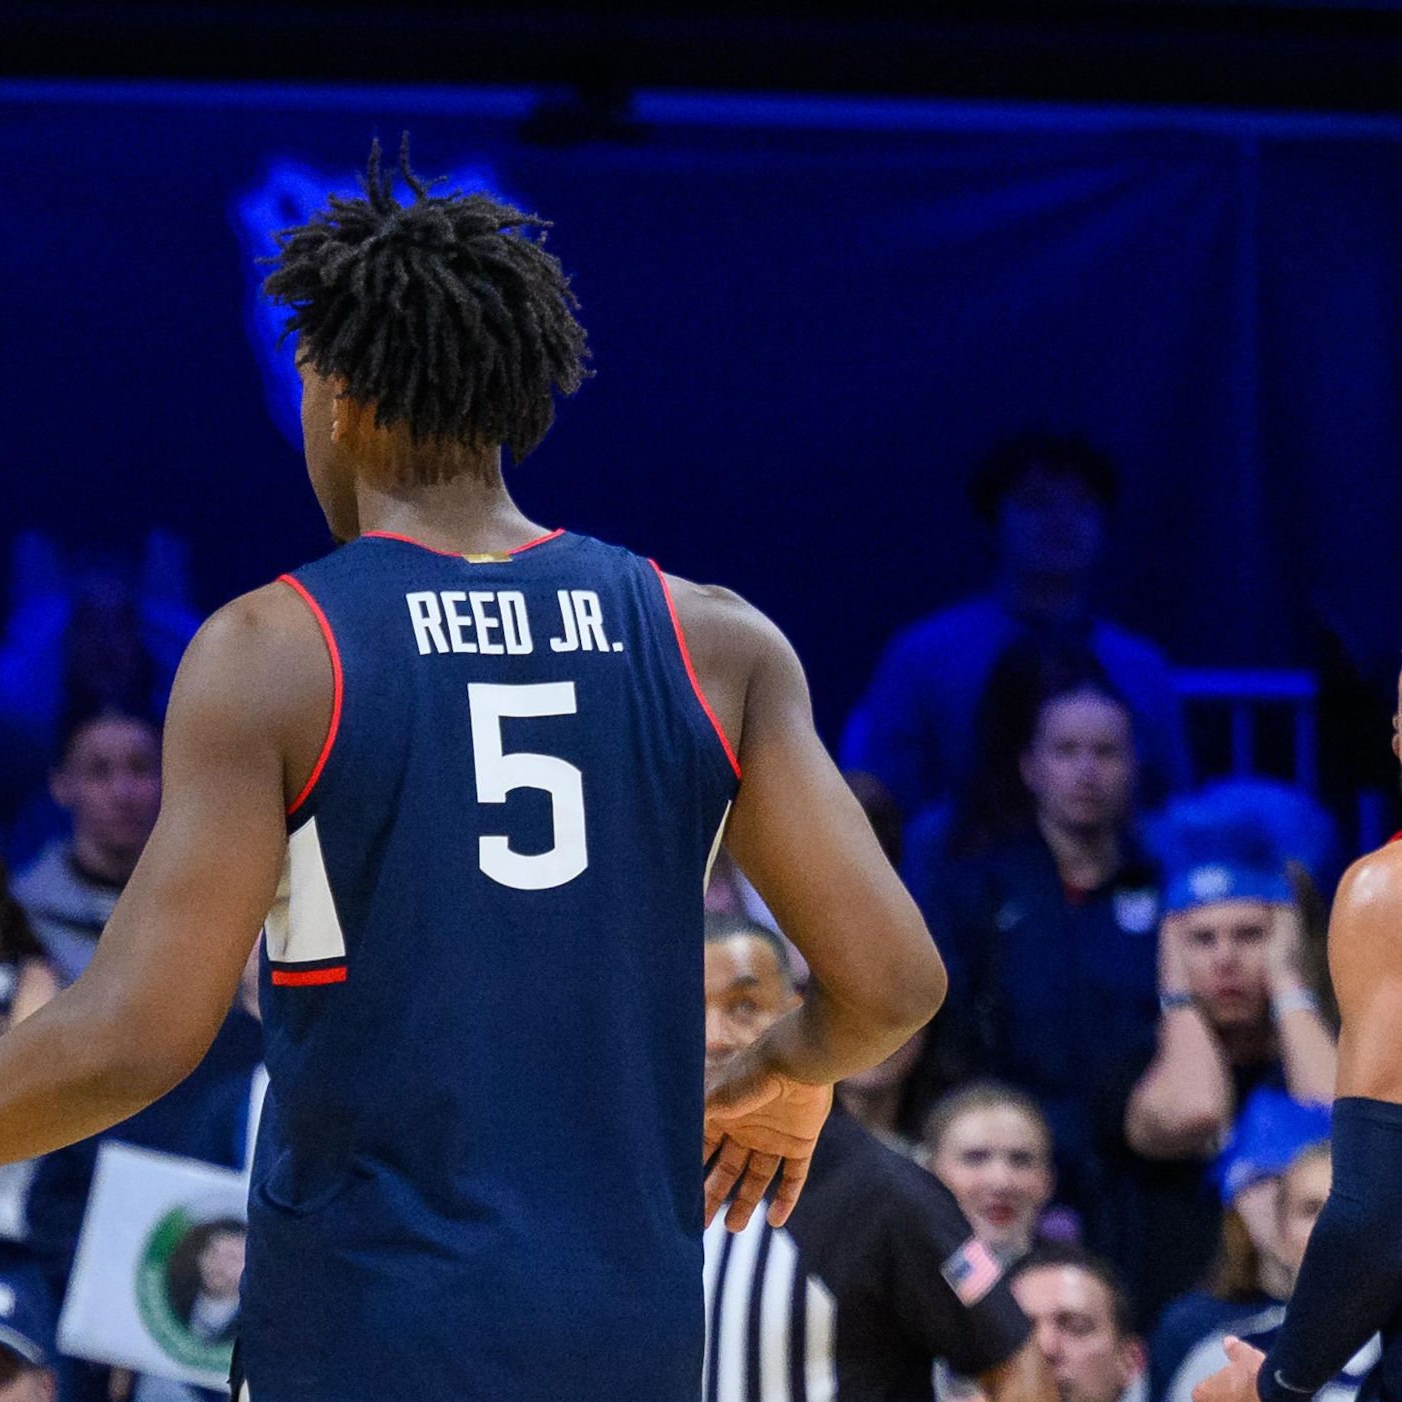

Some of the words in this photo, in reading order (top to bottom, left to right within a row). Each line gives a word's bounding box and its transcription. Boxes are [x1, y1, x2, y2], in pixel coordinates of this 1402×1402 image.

[406, 590, 533, 655] REED
[549, 589, 625, 653] JR.
[467, 681, 589, 890] 5
